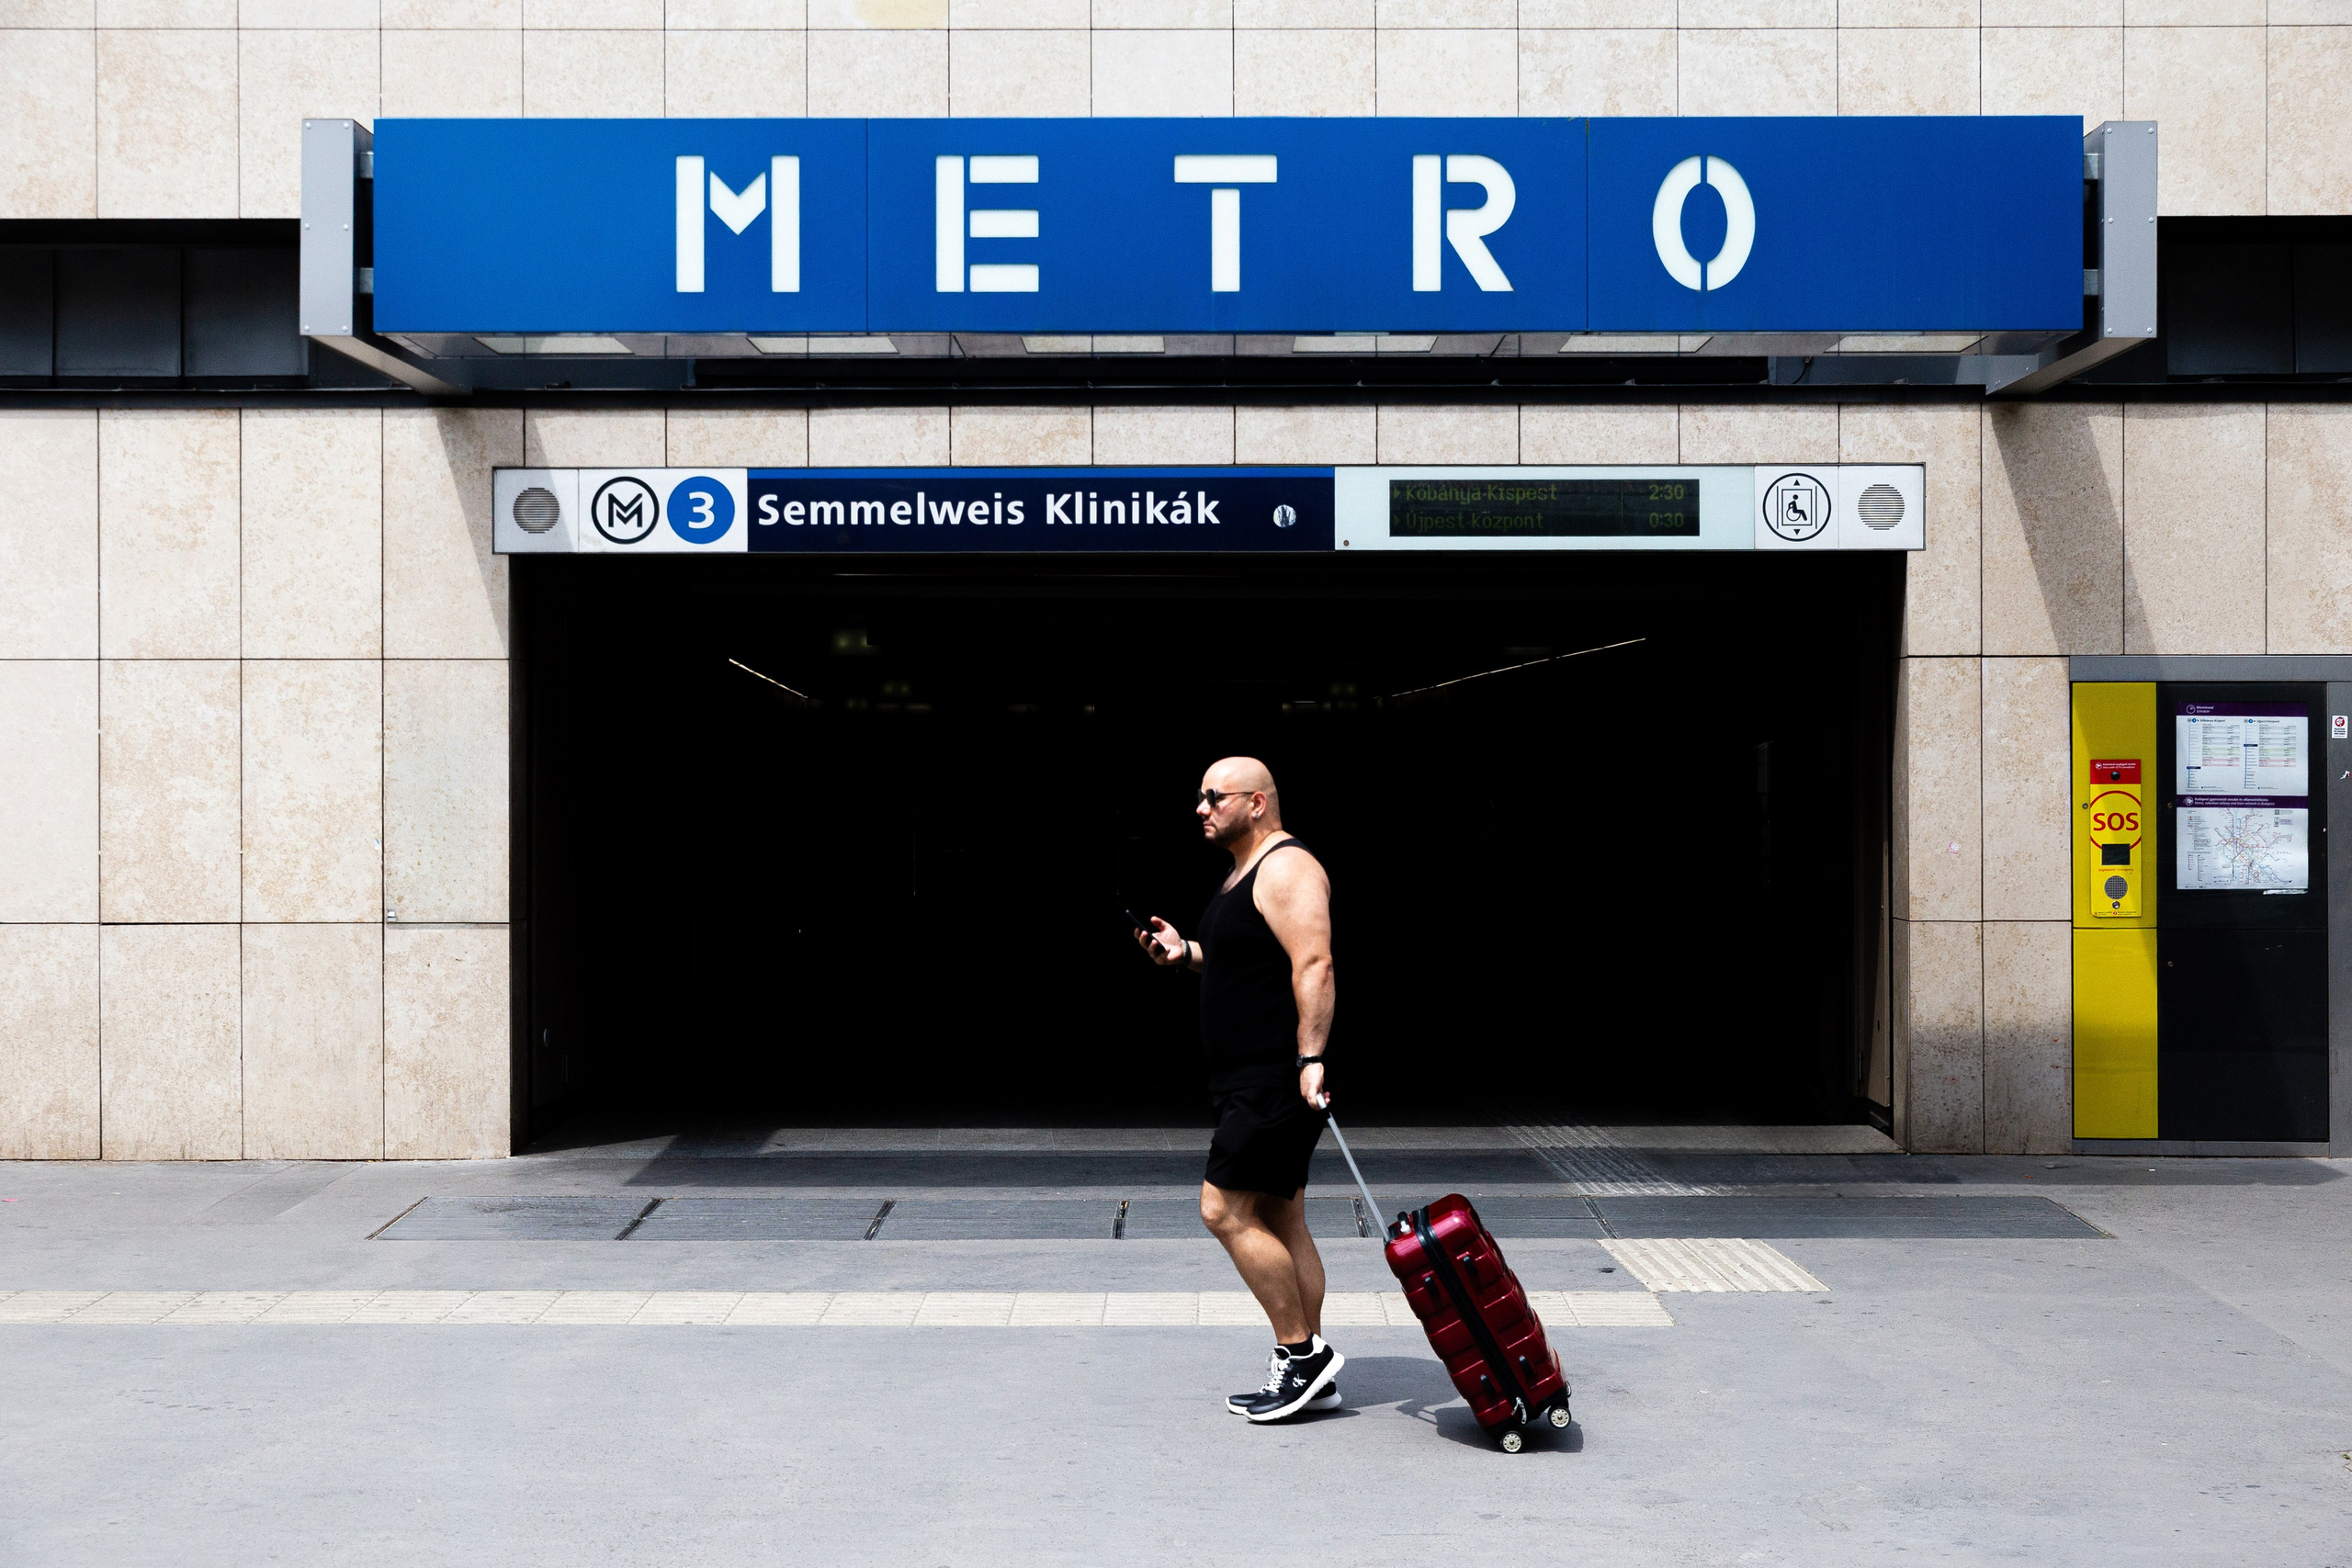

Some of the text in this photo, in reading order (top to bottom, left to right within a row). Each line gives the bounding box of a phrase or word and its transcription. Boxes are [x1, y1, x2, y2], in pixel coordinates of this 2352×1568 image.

[676, 154, 1756, 293] METRO
[1648, 483, 1684, 501] 2:30
[688, 491, 716, 529] 3
[758, 491, 1024, 526] Semmelweis
[1046, 491, 1221, 525] Klinikák
[1648, 512, 1684, 528] 0:30
[2092, 812, 2140, 832] SOS
